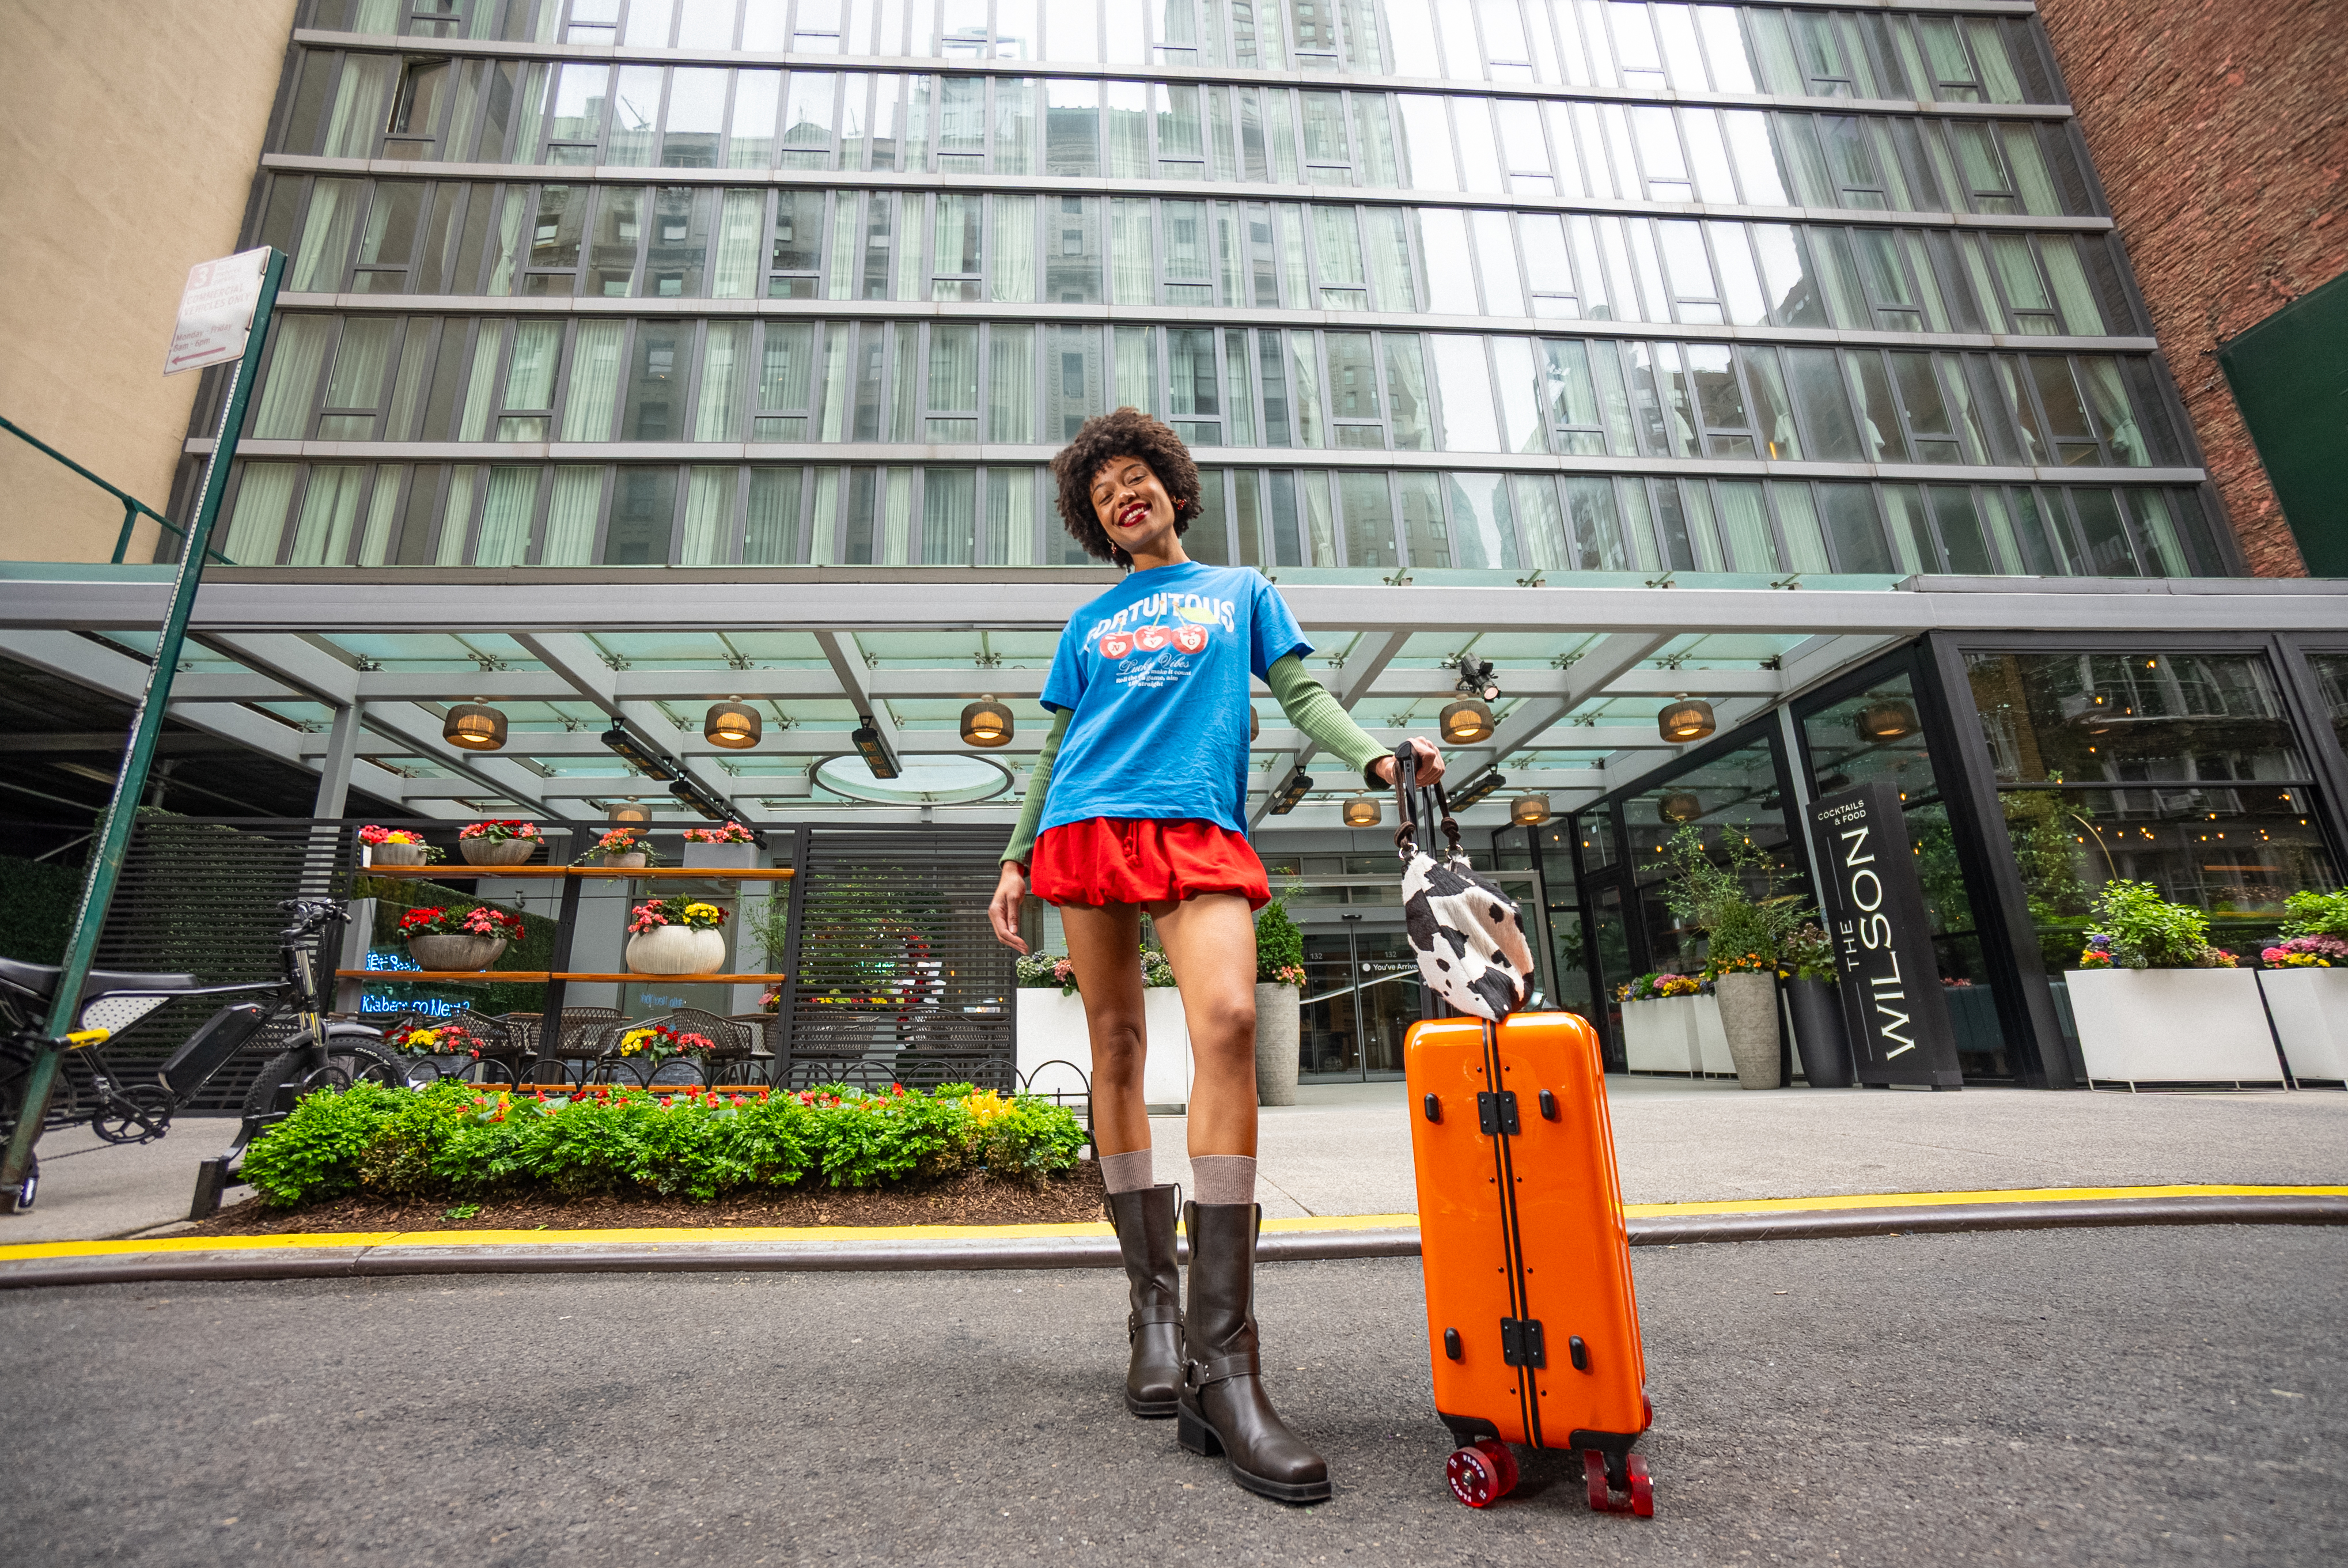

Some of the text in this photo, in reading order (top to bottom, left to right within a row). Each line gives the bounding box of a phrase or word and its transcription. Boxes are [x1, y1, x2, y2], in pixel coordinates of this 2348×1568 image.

[194, 267, 210, 287] 3
[184, 293, 251, 315] VEHICLES ONLY
[187, 284, 243, 304] COMMERCIAL
[176, 331, 203, 343] Monday
[211, 324, 232, 334] Friday
[1158, 652, 1191, 669] Vibes
[1817, 800, 1864, 821] COCKTAILS
[1842, 809, 1866, 823] FOOD
[1839, 920, 1860, 972] THE
[1840, 825, 1915, 1061] WILSON
[1373, 963, 1396, 971] You've
[1463, 1454, 1485, 1479] FLOYD
[1451, 1477, 1472, 1503] FLOYD
